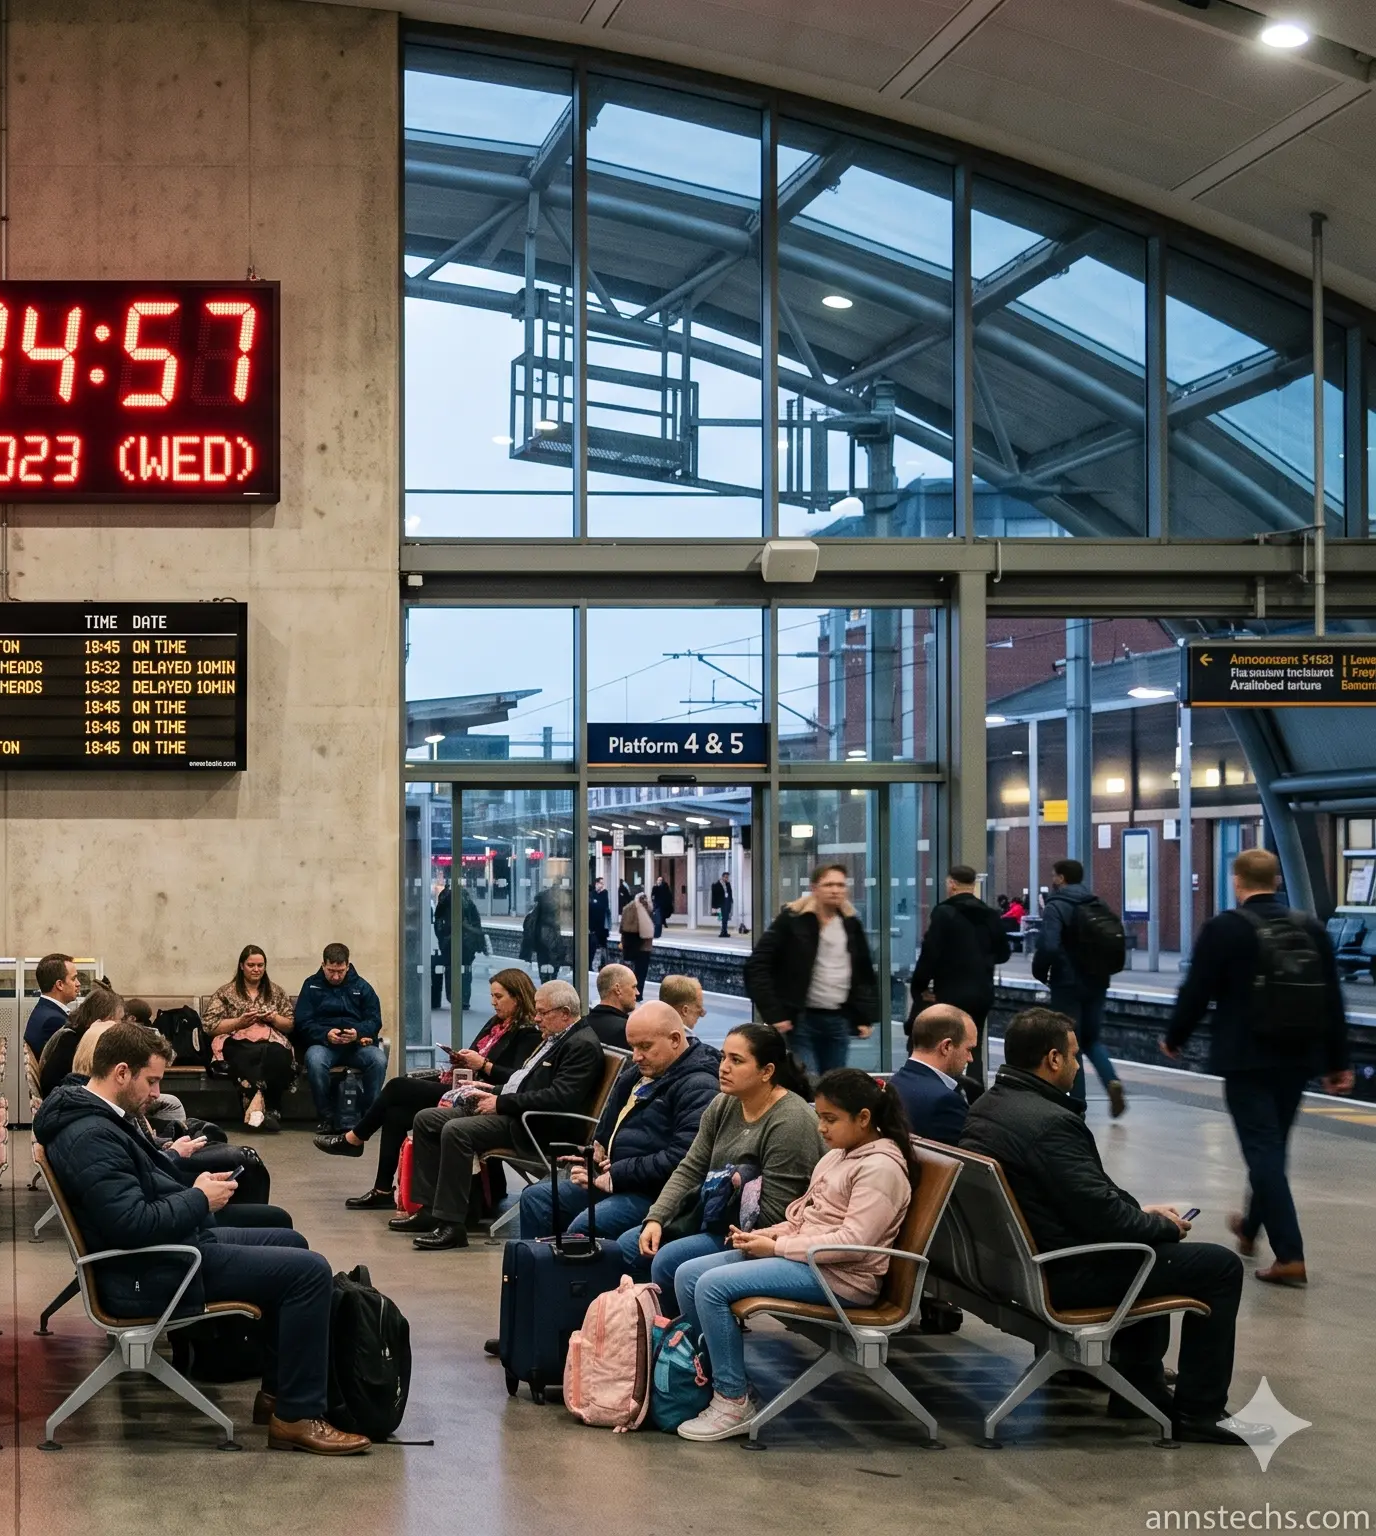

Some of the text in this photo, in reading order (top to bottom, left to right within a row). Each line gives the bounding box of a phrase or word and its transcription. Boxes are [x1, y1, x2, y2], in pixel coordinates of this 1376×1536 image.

[118, 434, 255, 484] (WED)
[84, 615, 118, 629] TIME
[132, 615, 167, 629] DATE
[84, 639, 121, 654] 18:45
[132, 639, 150, 654] ON
[154, 639, 187, 654] TIME
[0, 660, 43, 675] MEADS
[132, 660, 192, 675] DELAYED
[196, 660, 236, 675] 10MIN
[0, 679, 43, 694] MEADS
[132, 679, 192, 694] DELAYED
[196, 679, 236, 694] 10MIN
[132, 700, 150, 715] ON
[132, 720, 150, 735] ON
[84, 740, 121, 755] 18:45
[132, 740, 150, 755] ON
[609, 732, 744, 754] Platform 4 & 5
